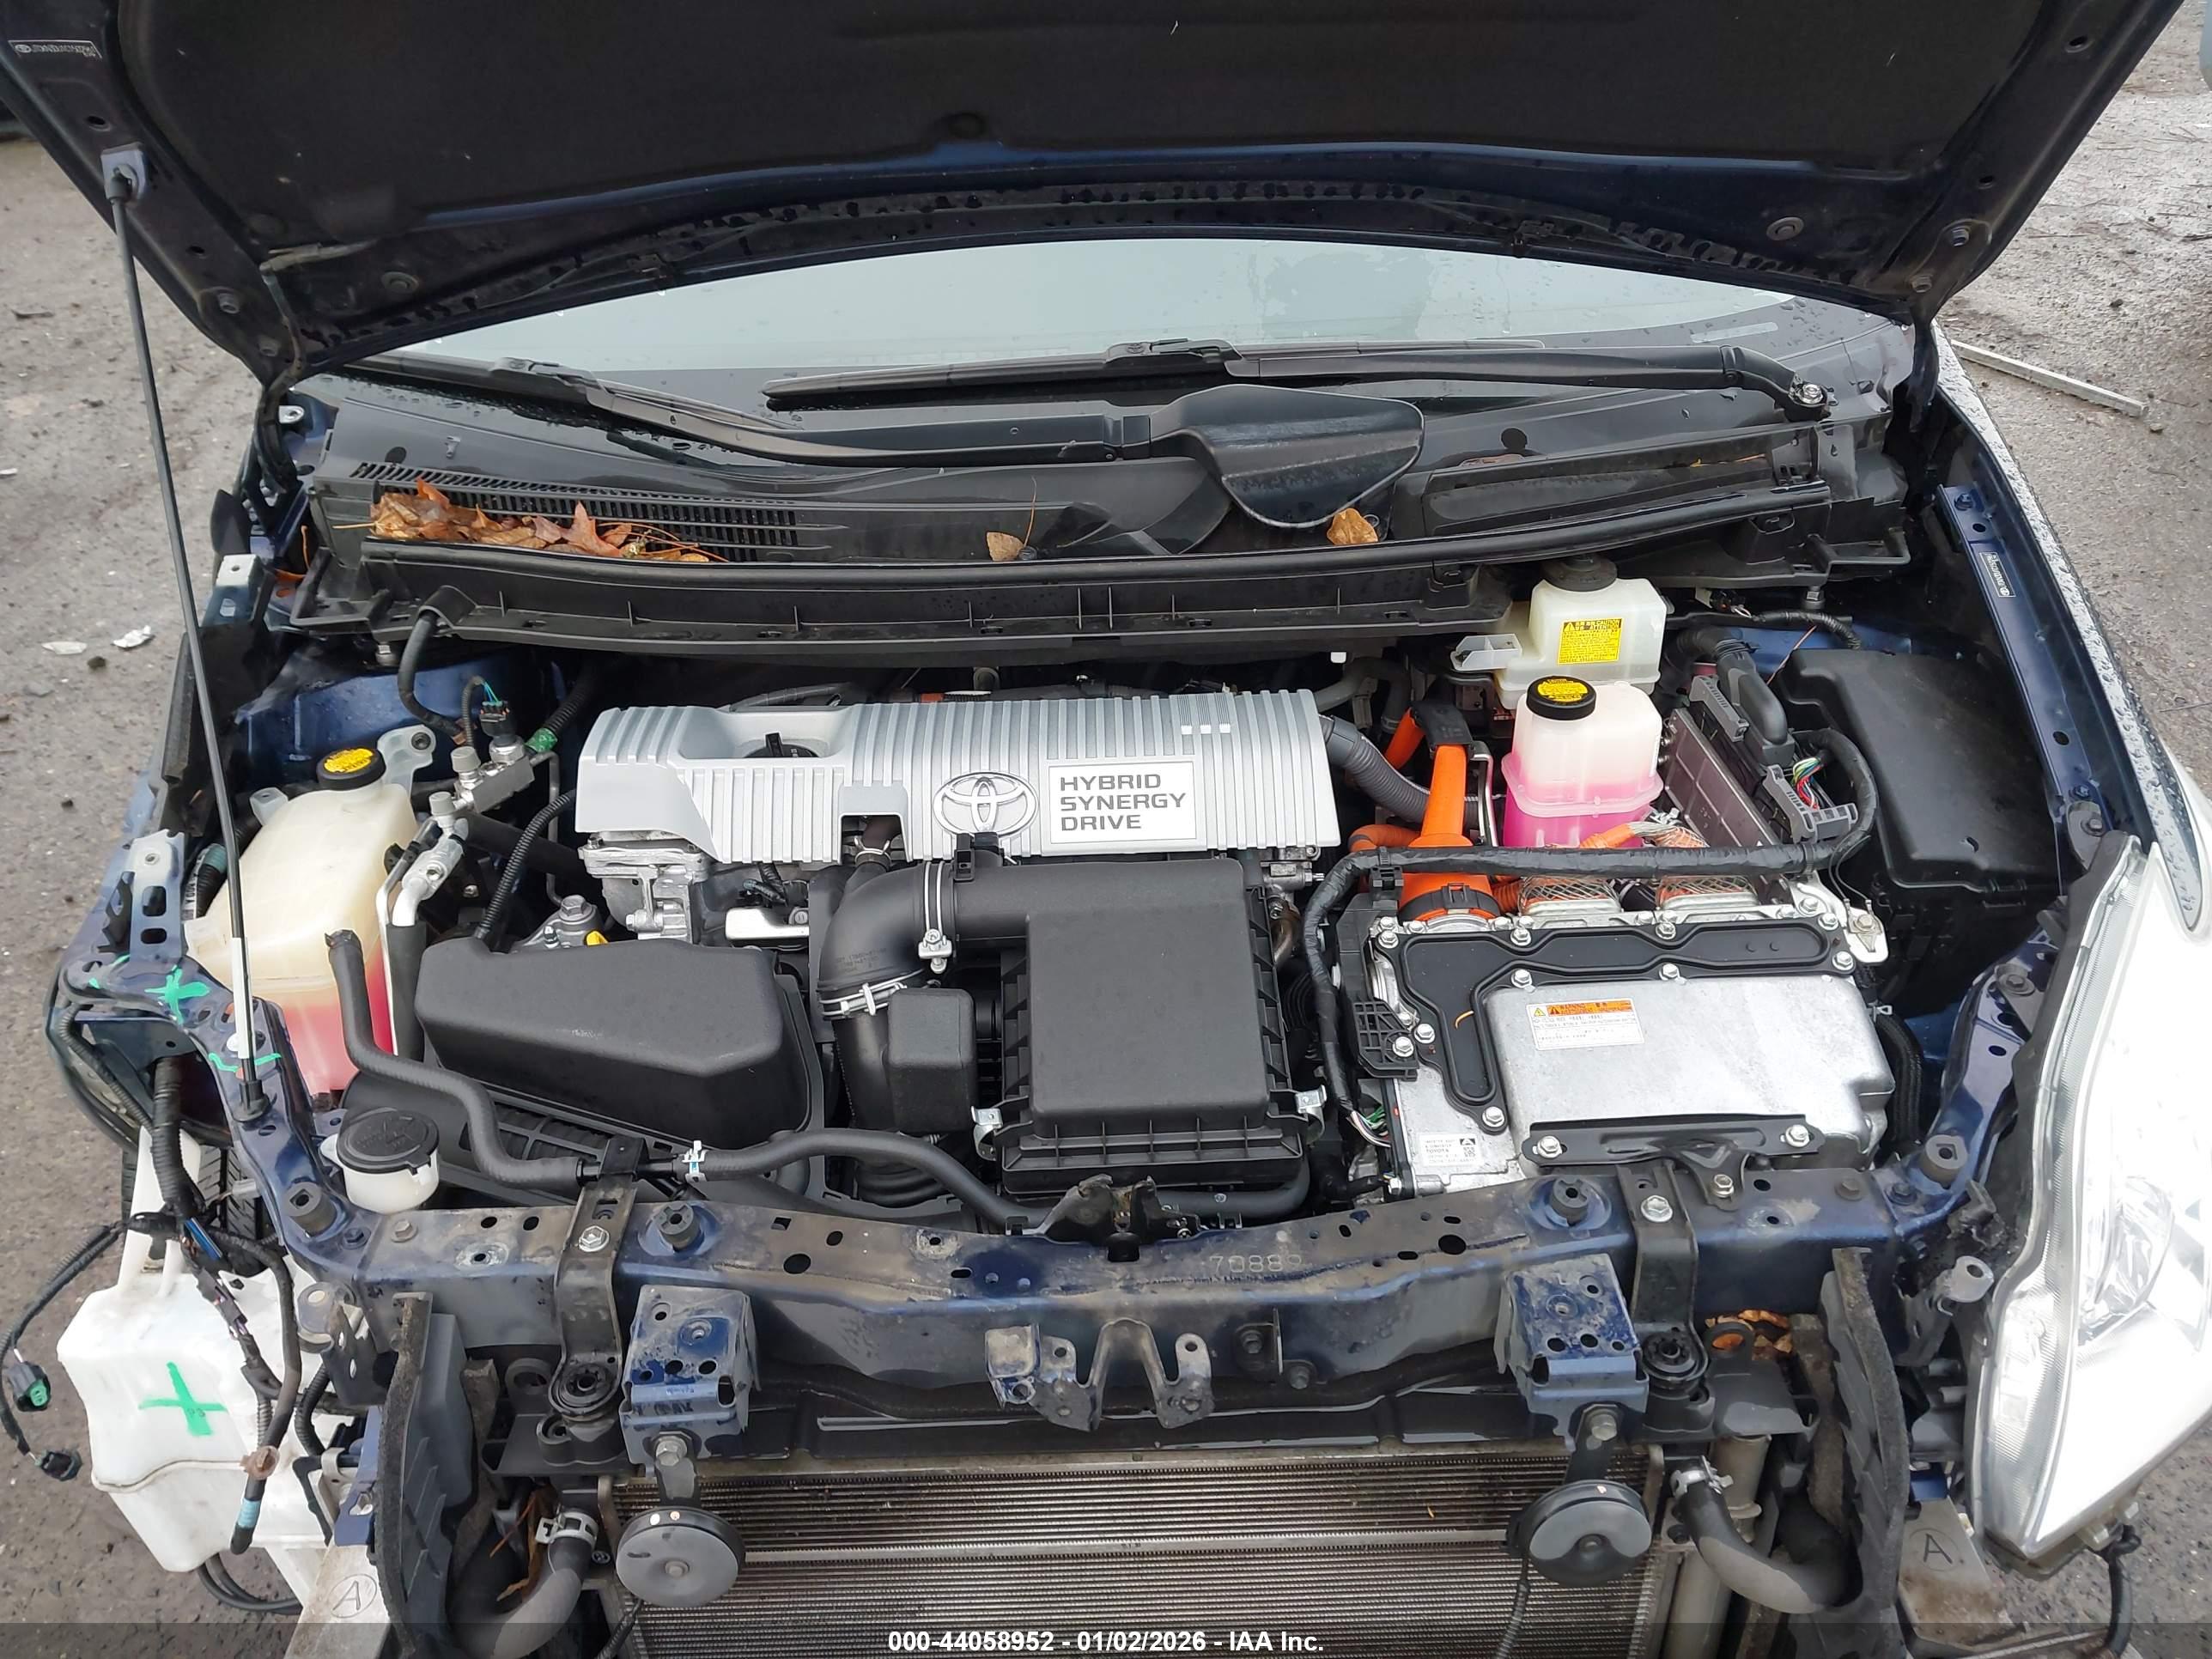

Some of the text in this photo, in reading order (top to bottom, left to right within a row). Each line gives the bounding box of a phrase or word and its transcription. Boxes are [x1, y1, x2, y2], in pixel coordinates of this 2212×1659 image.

[1060, 774, 1161, 791] HYBRID
[1060, 793, 1186, 811] SYNERGY
[1061, 814, 1141, 831] DRIVE
[1923, 1534, 1953, 1564] A
[332, 1580, 361, 1611] A
